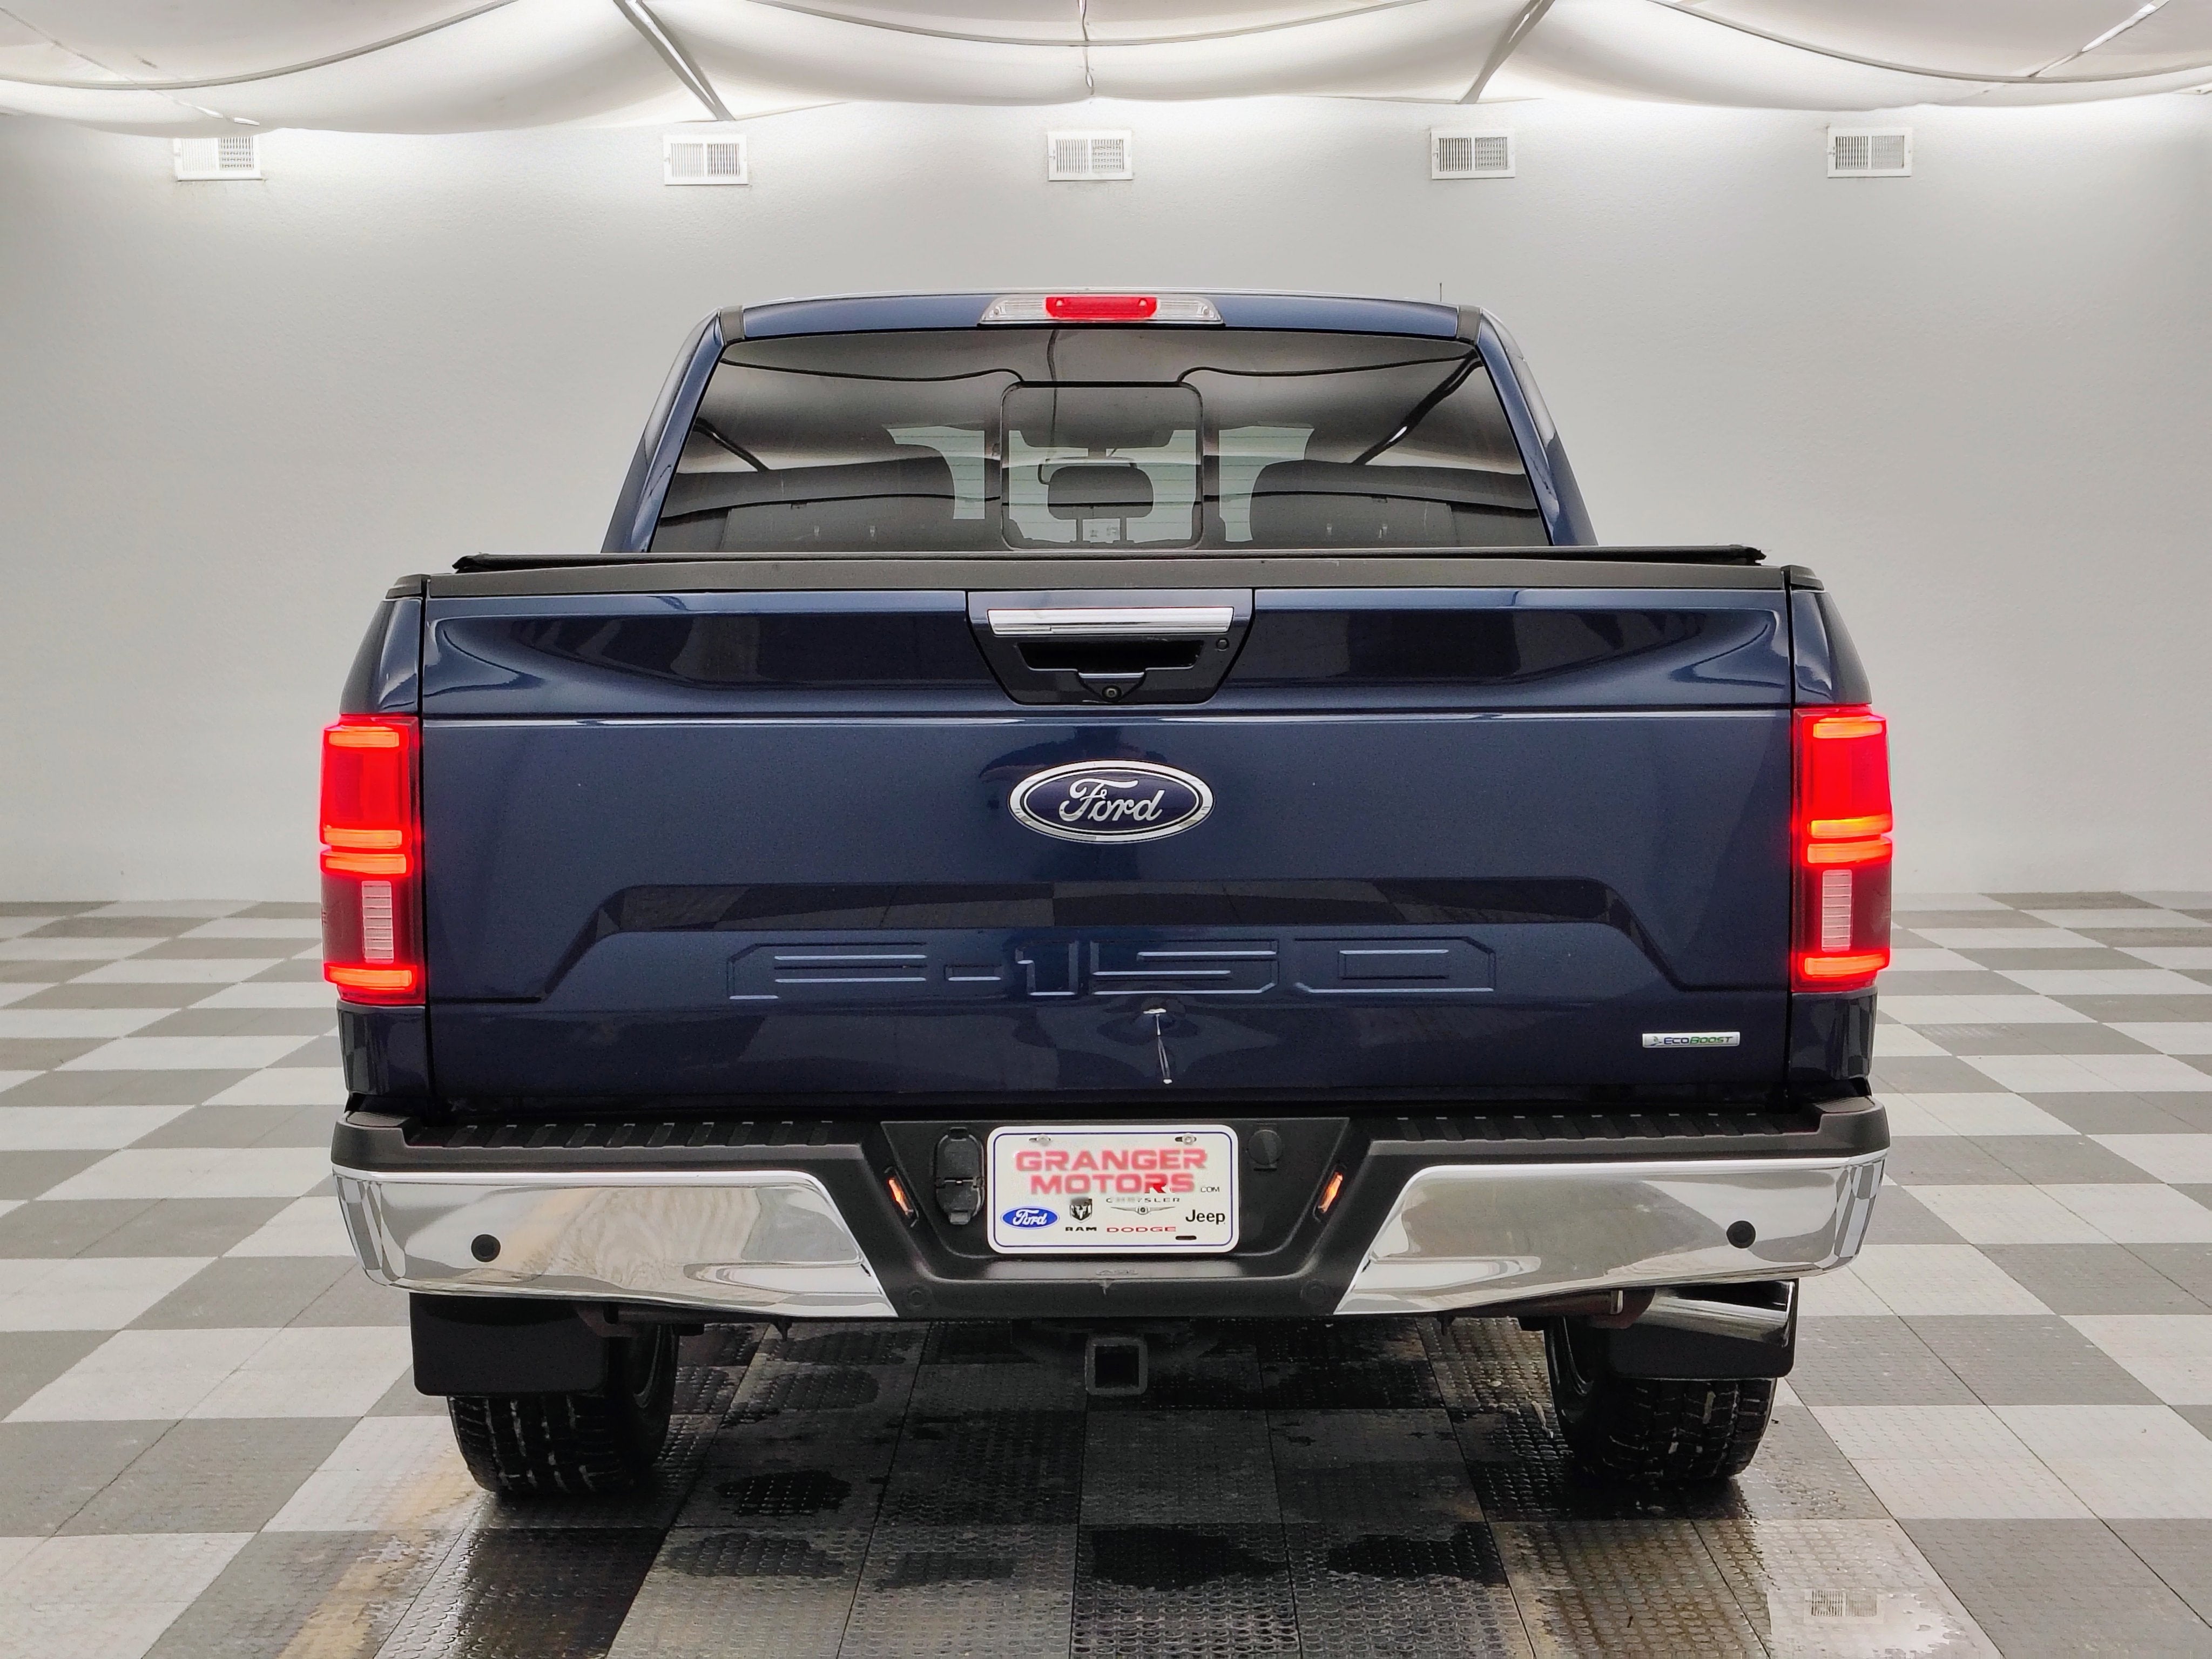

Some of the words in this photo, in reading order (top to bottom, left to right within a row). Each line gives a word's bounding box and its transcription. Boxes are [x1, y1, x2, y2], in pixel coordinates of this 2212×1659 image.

[1058, 777, 1165, 822] Ford
[1015, 1148, 1208, 1171] GRANGER
[1030, 1172, 1195, 1194] MOTORS
[1012, 1209, 1048, 1225] Ford
[1185, 1209, 1225, 1225] Jeep
